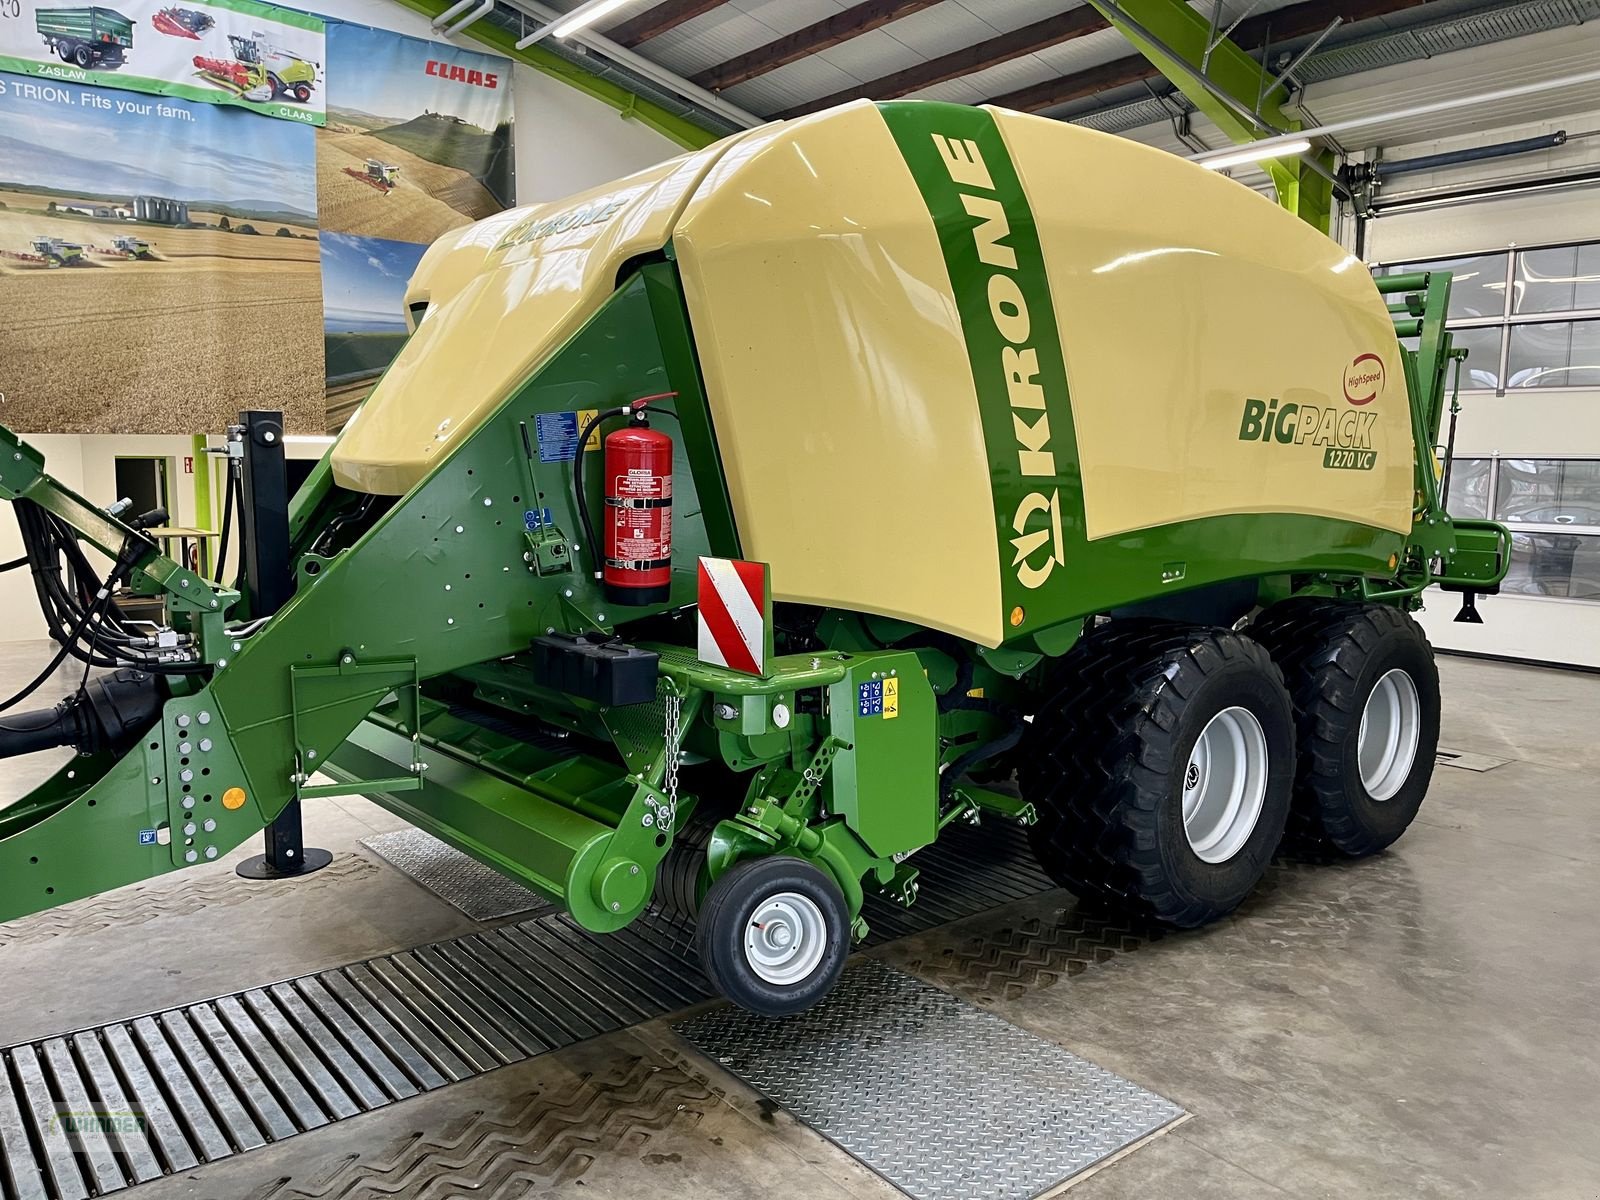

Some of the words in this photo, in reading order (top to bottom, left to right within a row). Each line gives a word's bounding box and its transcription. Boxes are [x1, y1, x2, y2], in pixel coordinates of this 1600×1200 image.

[38, 64, 86, 80] ZASLAW
[425, 60, 498, 88] CLAAS
[11, 82, 75, 105] TRION.
[81, 92, 112, 109] Fits
[116, 100, 152, 116] your
[157, 105, 196, 122] farm.
[280, 107, 313, 121] CLAAS
[931, 133, 1057, 477] KRONE
[1348, 370, 1381, 388] HighSpeed
[1329, 450, 1355, 468] 1270
[1357, 452, 1372, 468] VC
